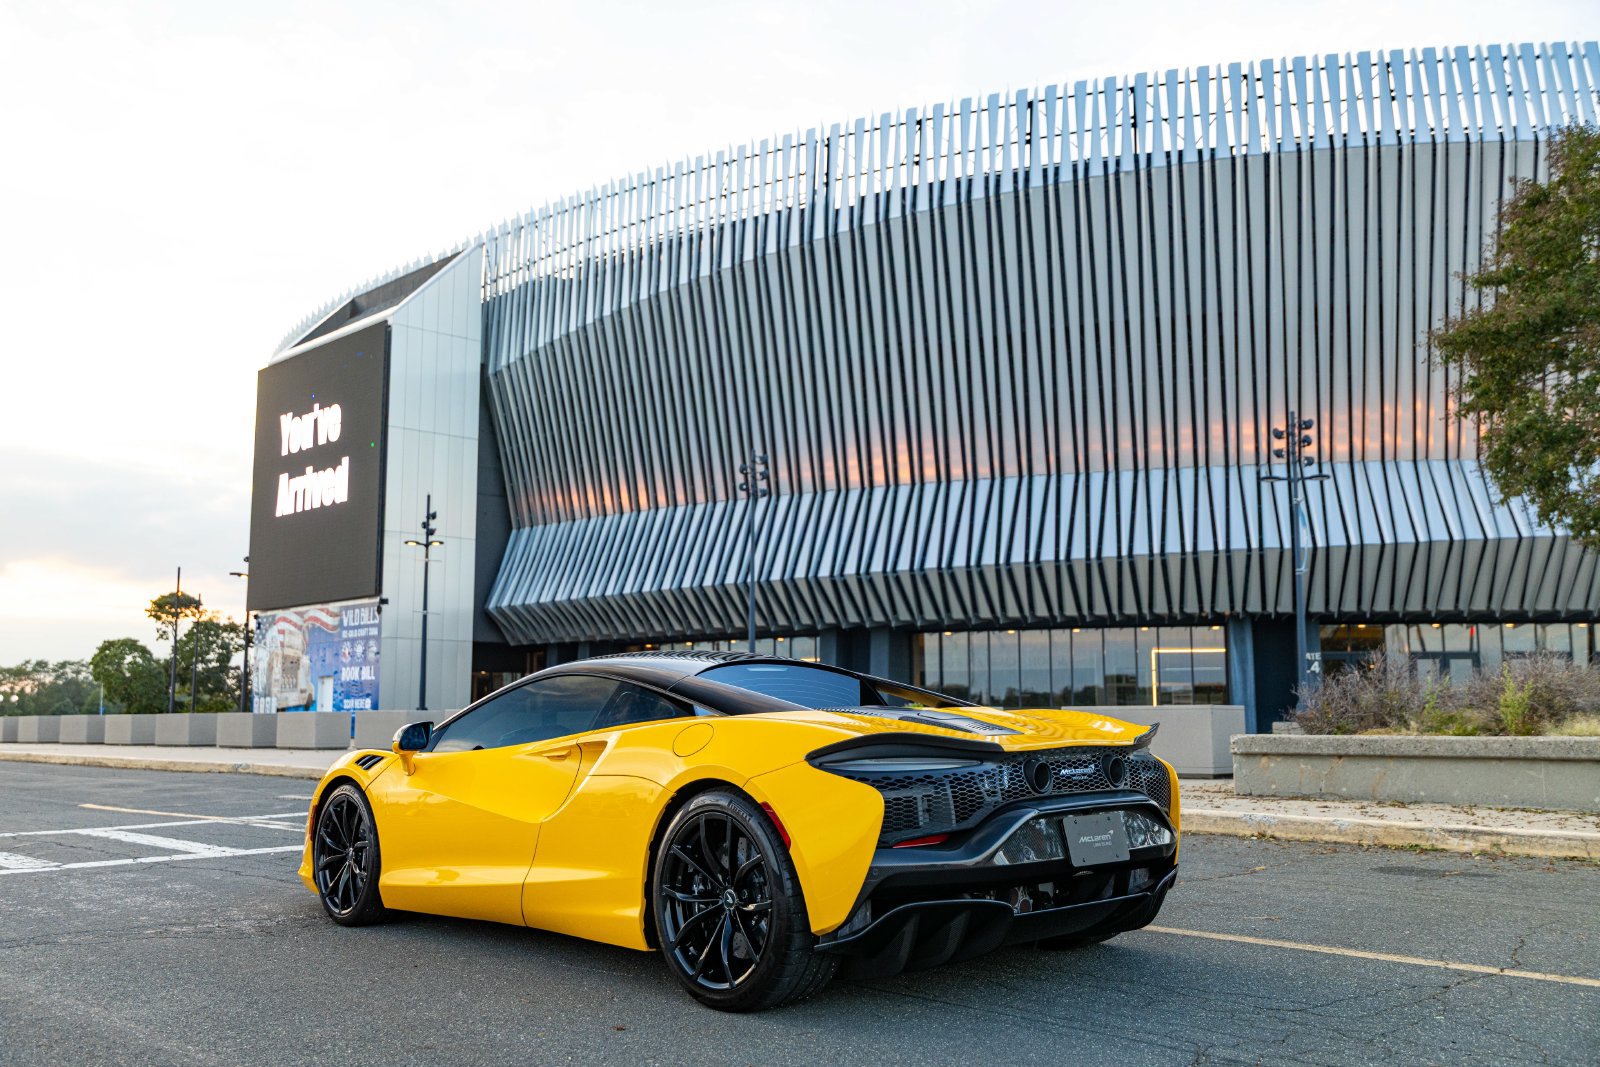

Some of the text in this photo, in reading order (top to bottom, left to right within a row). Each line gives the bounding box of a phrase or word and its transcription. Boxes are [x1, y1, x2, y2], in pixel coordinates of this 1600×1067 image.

[276, 456, 350, 517] Arrived
[1306, 652, 1321, 660] ATE
[1060, 767, 1094, 776] McLaren
[1079, 834, 1111, 844] McLaren
